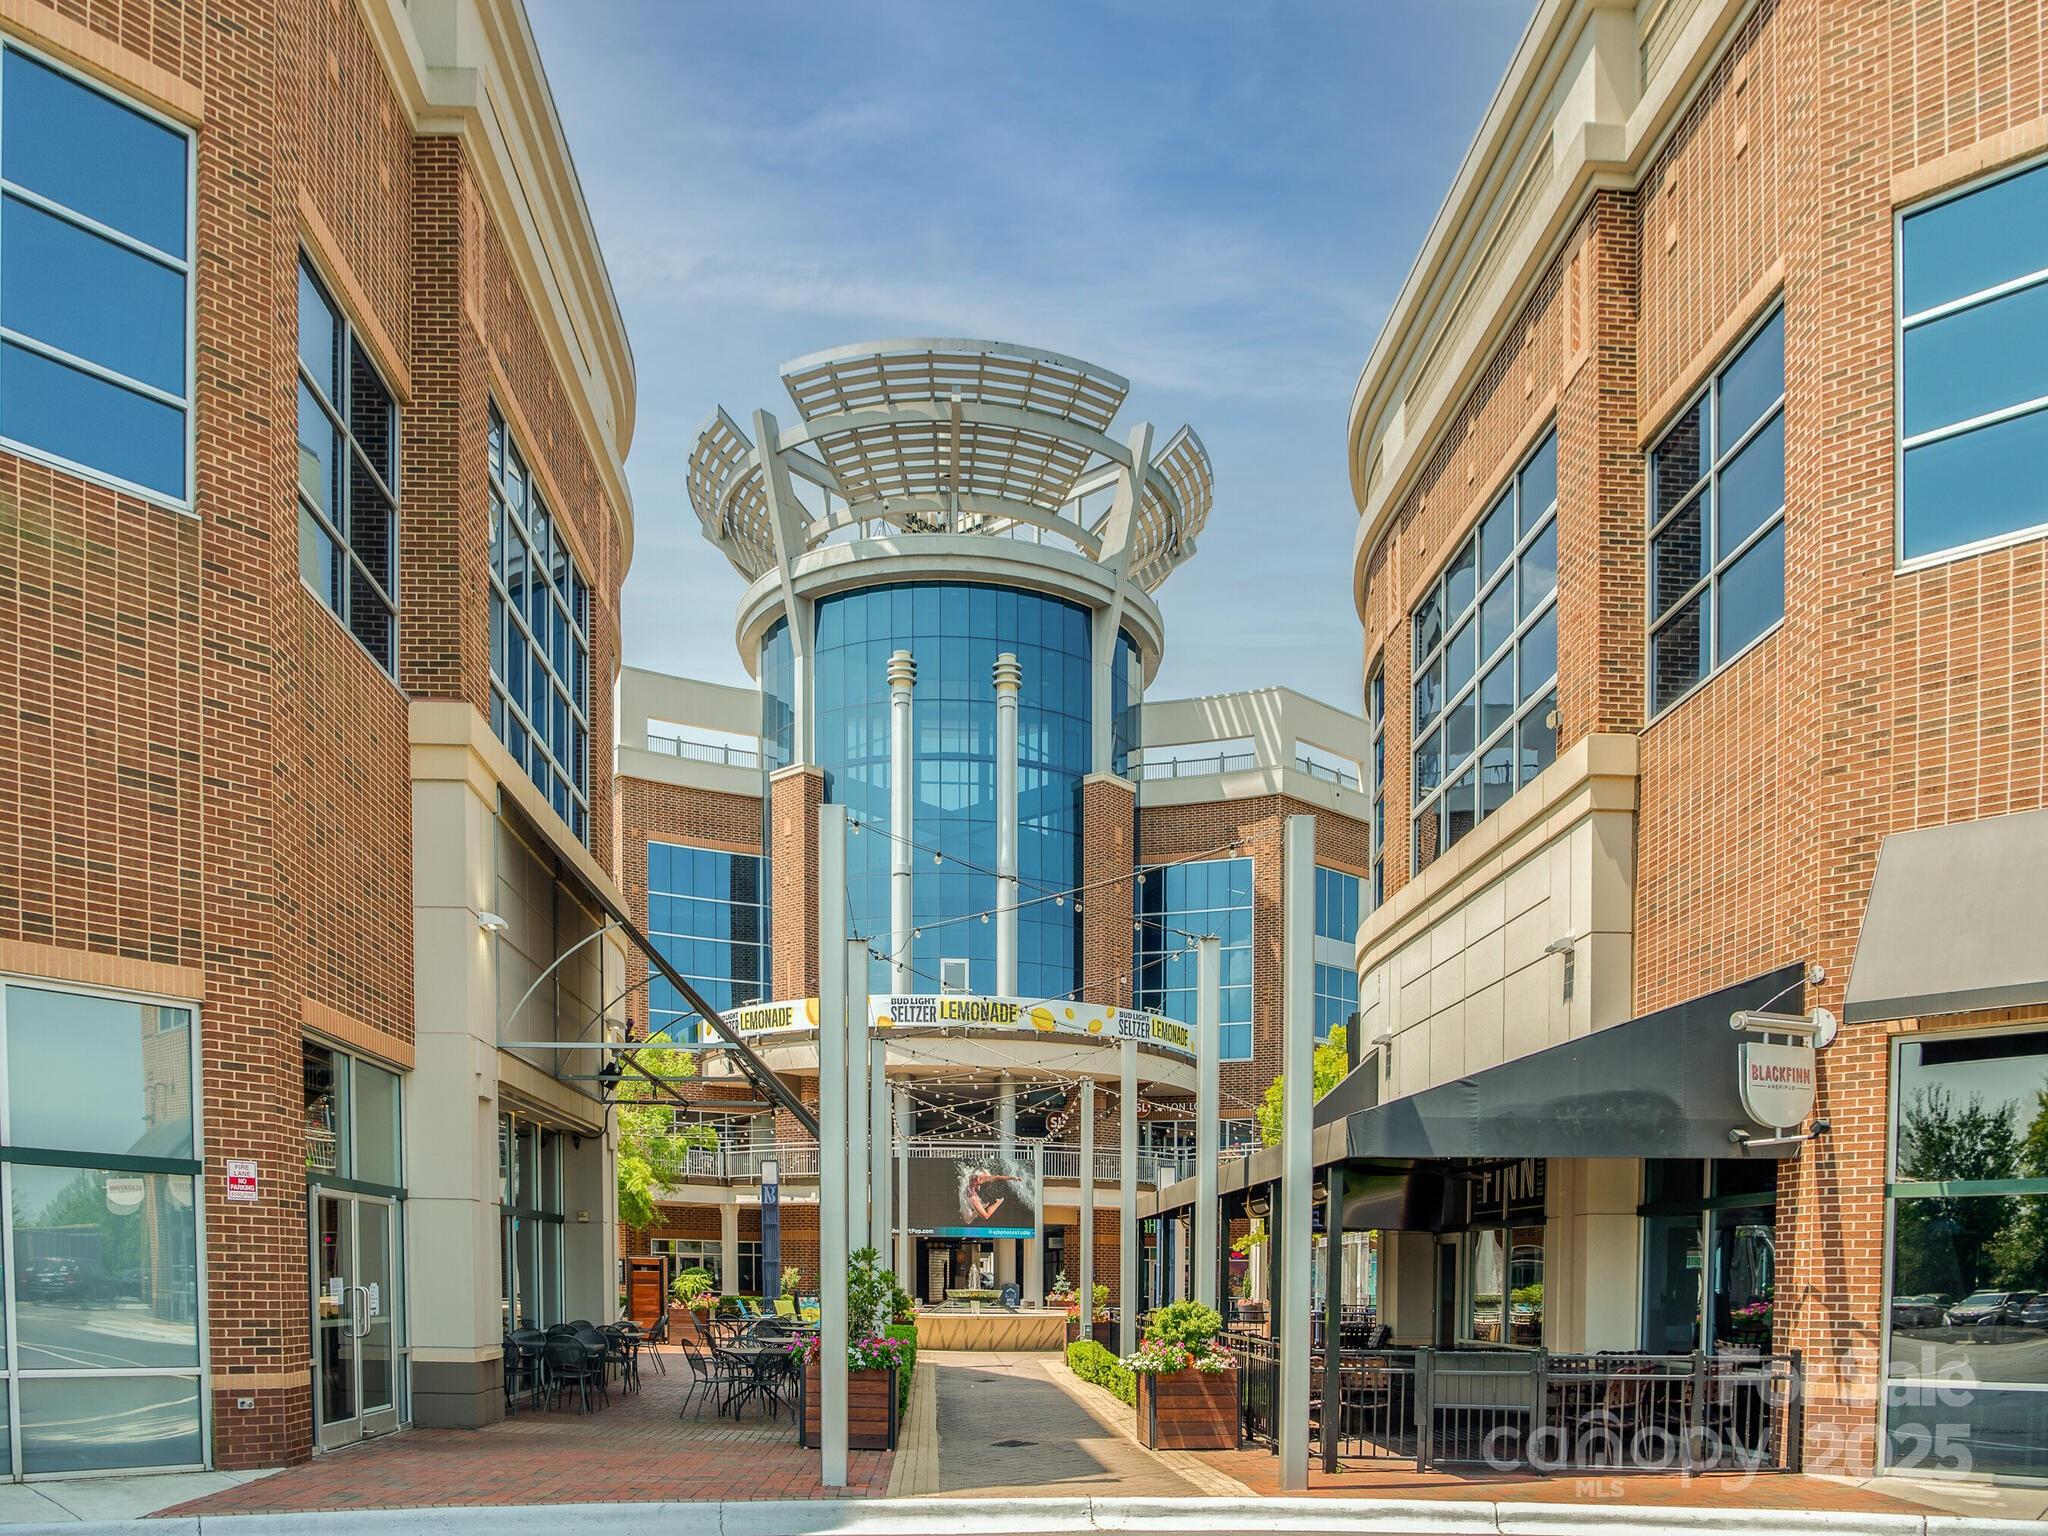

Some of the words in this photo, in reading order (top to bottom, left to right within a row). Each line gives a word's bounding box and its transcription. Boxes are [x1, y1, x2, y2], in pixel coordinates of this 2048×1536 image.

[740, 1007, 793, 1031] LEMONADE
[891, 1005, 937, 1023] SELTZER
[940, 1001, 1018, 1023] LEMONADE
[1119, 1011, 1132, 1019] BUD
[1133, 1014, 1149, 1022] LIGHT
[1118, 1019, 1150, 1039] SELTZER
[1152, 1019, 1189, 1047] LEMONADE
[1751, 1064, 1811, 1084] BLACKFINN
[1482, 1157, 1535, 1204] FINN
